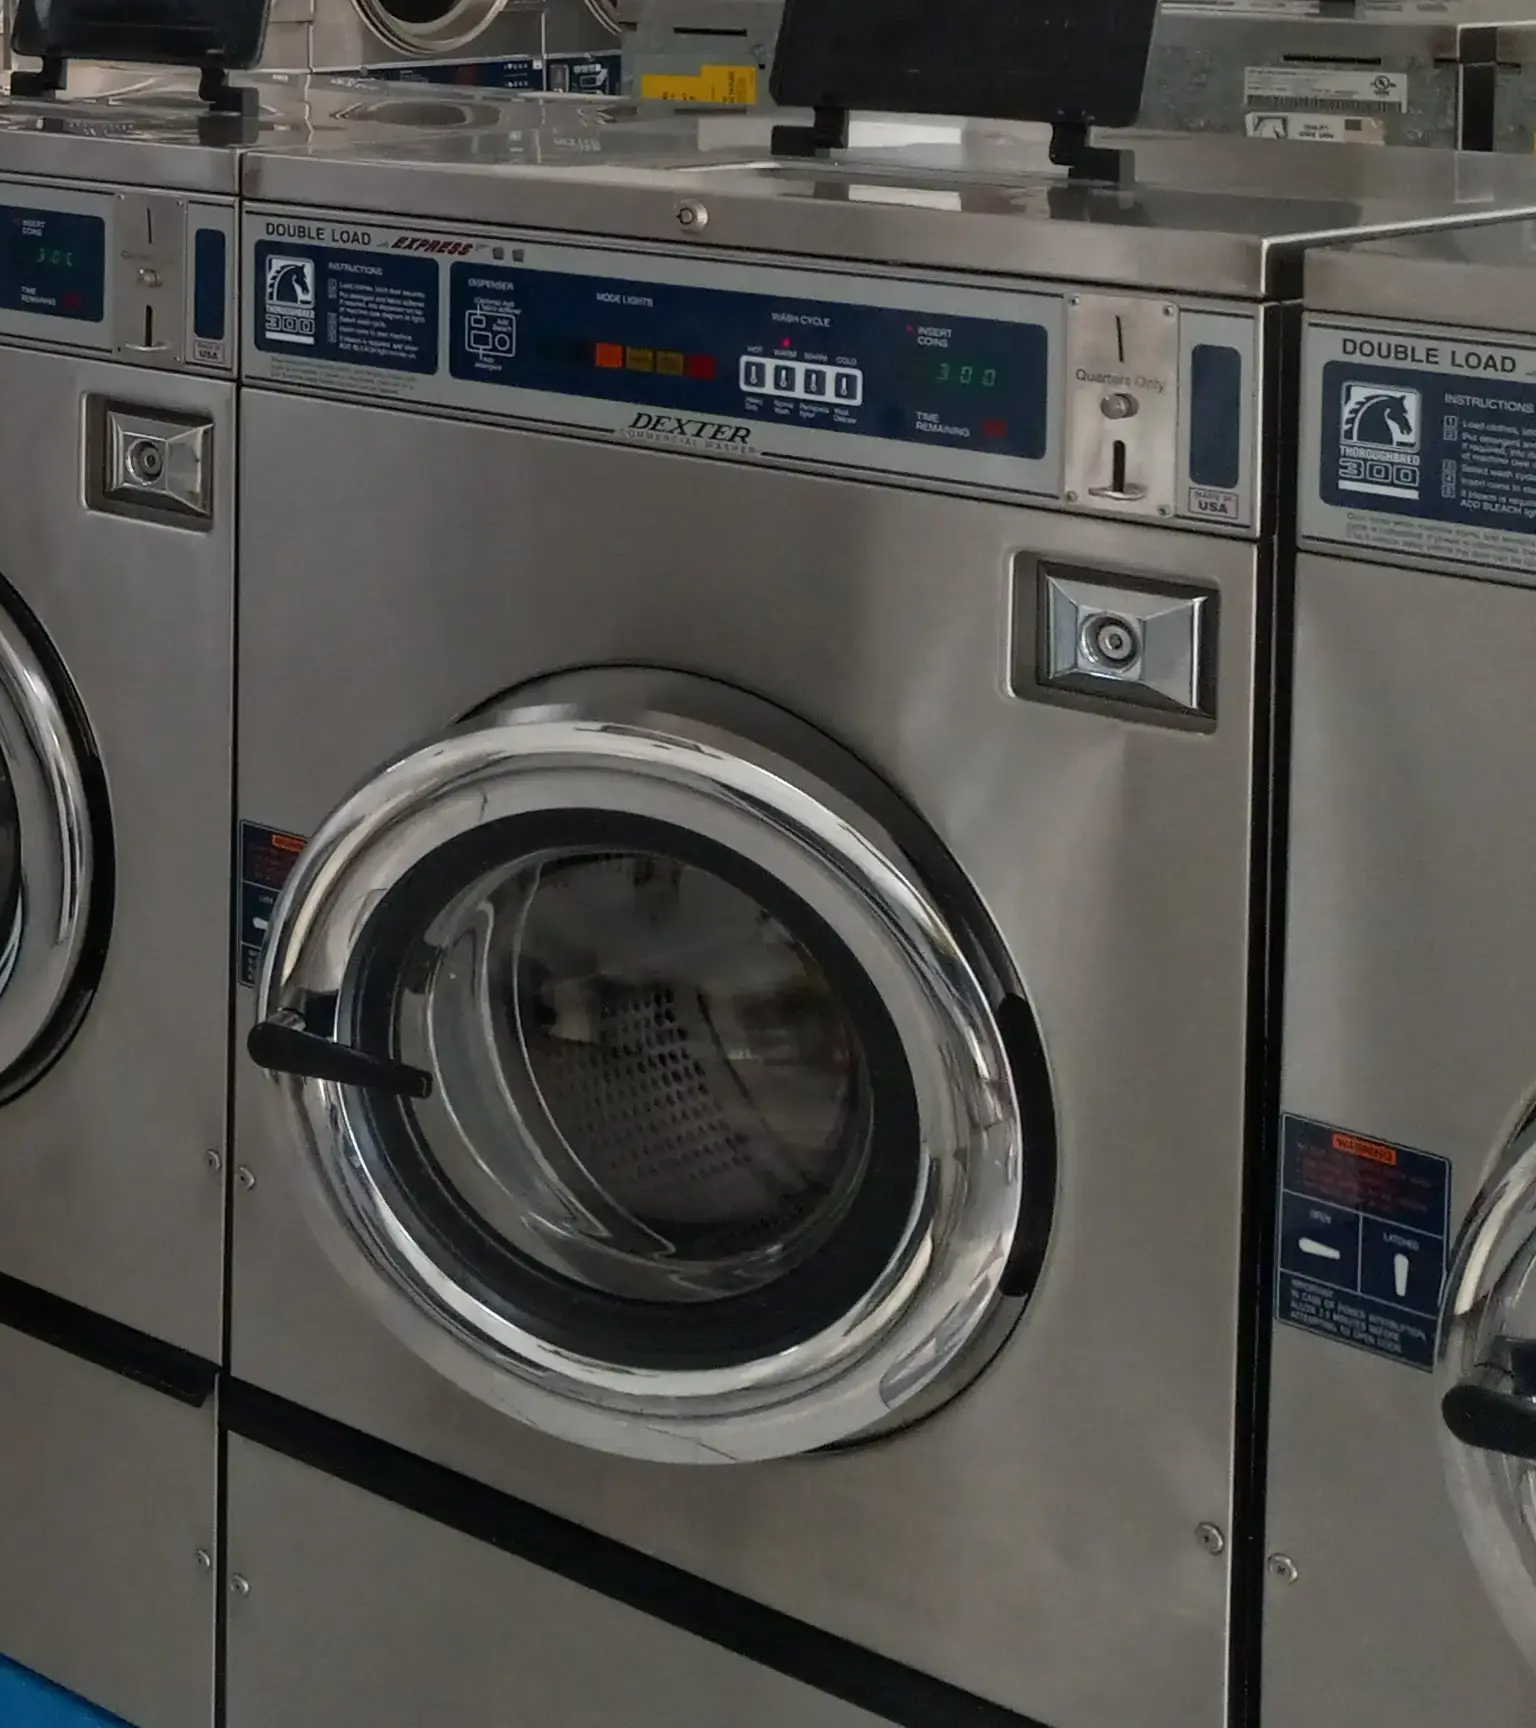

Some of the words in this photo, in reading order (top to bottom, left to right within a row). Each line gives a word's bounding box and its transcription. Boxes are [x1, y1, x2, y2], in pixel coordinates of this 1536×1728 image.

[266, 222, 325, 241] DOUBLE
[332, 229, 371, 246] LOAD
[391, 236, 474, 256] EXPRESS
[468, 278, 514, 291] DISPENSER
[596, 292, 621, 304] MODE
[771, 312, 799, 324] WASH
[800, 315, 832, 328] CYCLE
[917, 326, 952, 339] INSERT
[917, 336, 949, 348] COINS
[199, 349, 219, 360] USA
[1342, 338, 1440, 366] DOUBLE
[1451, 350, 1517, 374] LOAD
[1076, 368, 1132, 387] Quarters
[1135, 375, 1166, 393] Only
[1444, 393, 1535, 414] INSTRUCTIONS
[916, 411, 940, 423] TIME
[628, 412, 752, 445] DEXTER
[916, 421, 970, 438] REMAINING
[1339, 445, 1420, 466] THOROUGHBRED
[1338, 458, 1420, 487] 300
[1198, 500, 1228, 514] USA
